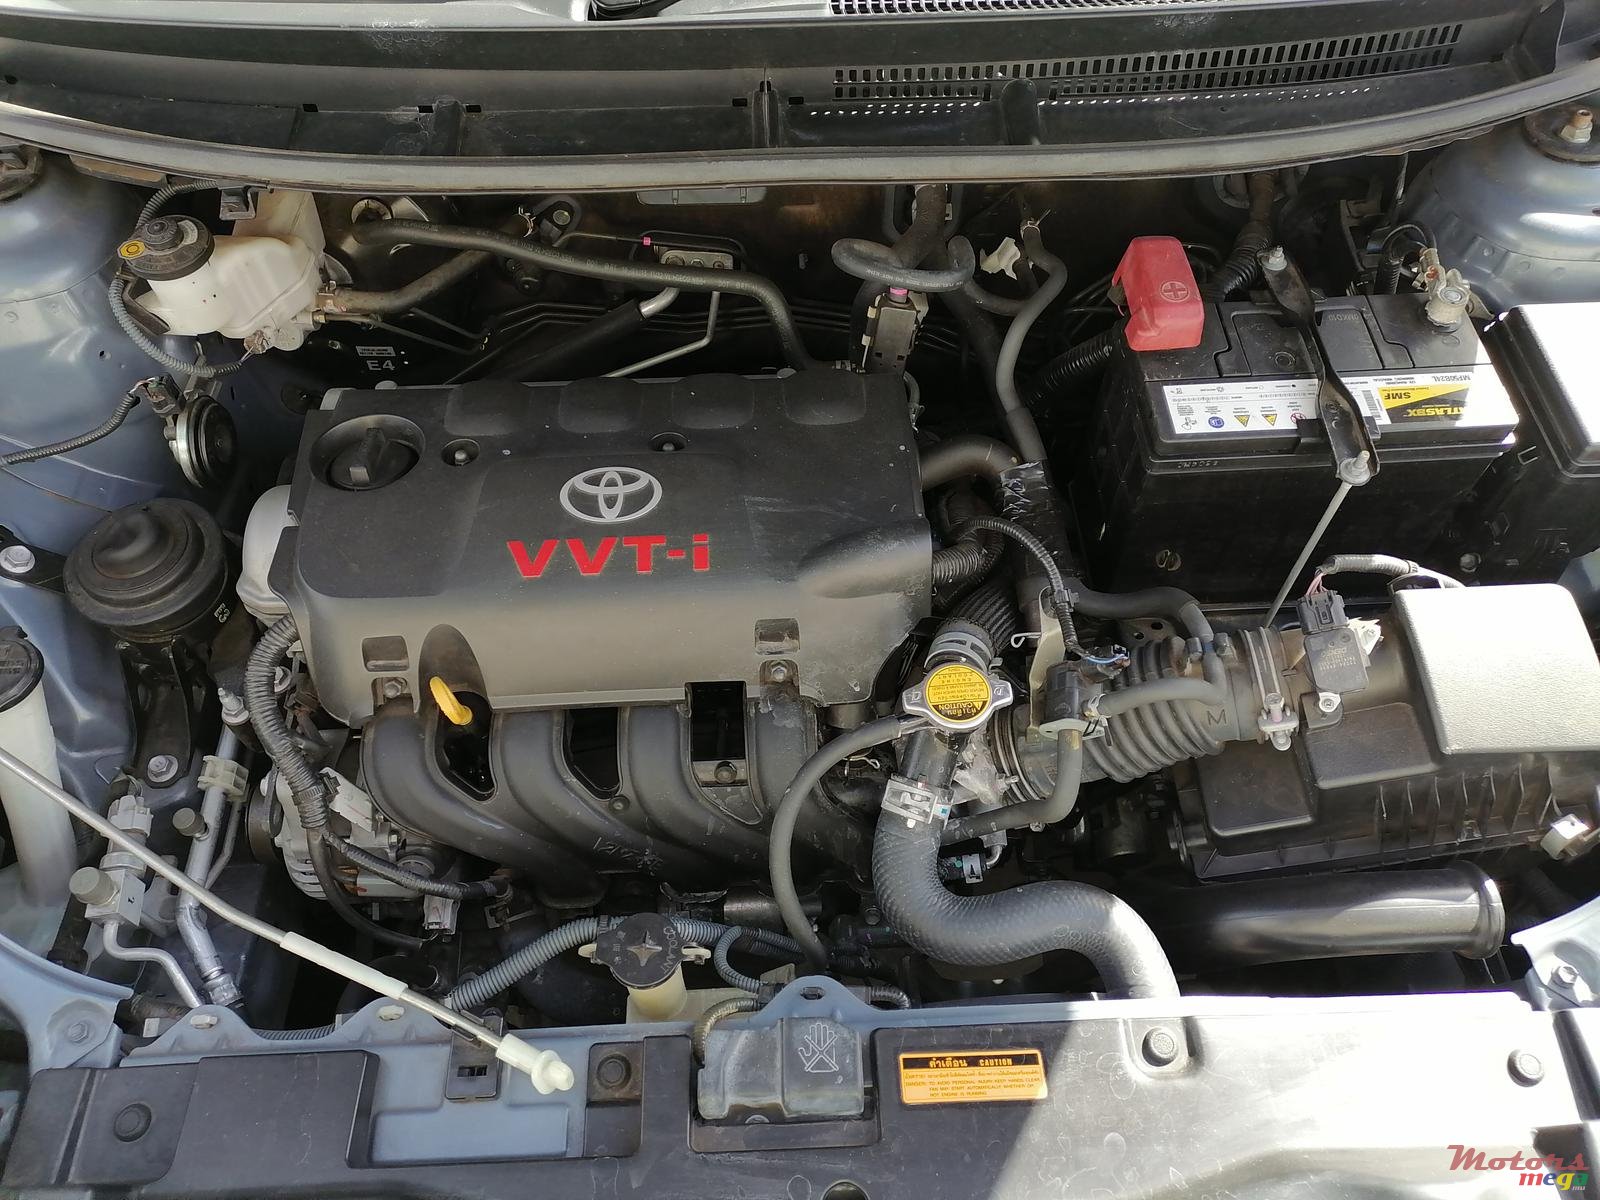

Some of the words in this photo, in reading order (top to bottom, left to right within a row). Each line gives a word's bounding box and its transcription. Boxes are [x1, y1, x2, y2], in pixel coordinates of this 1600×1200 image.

[366, 360, 396, 371] E4
[1384, 392, 1411, 400] SMF
[506, 532, 710, 578] VVT-i
[938, 702, 973, 711] CAUTION
[979, 1058, 1013, 1067] CAUTION
